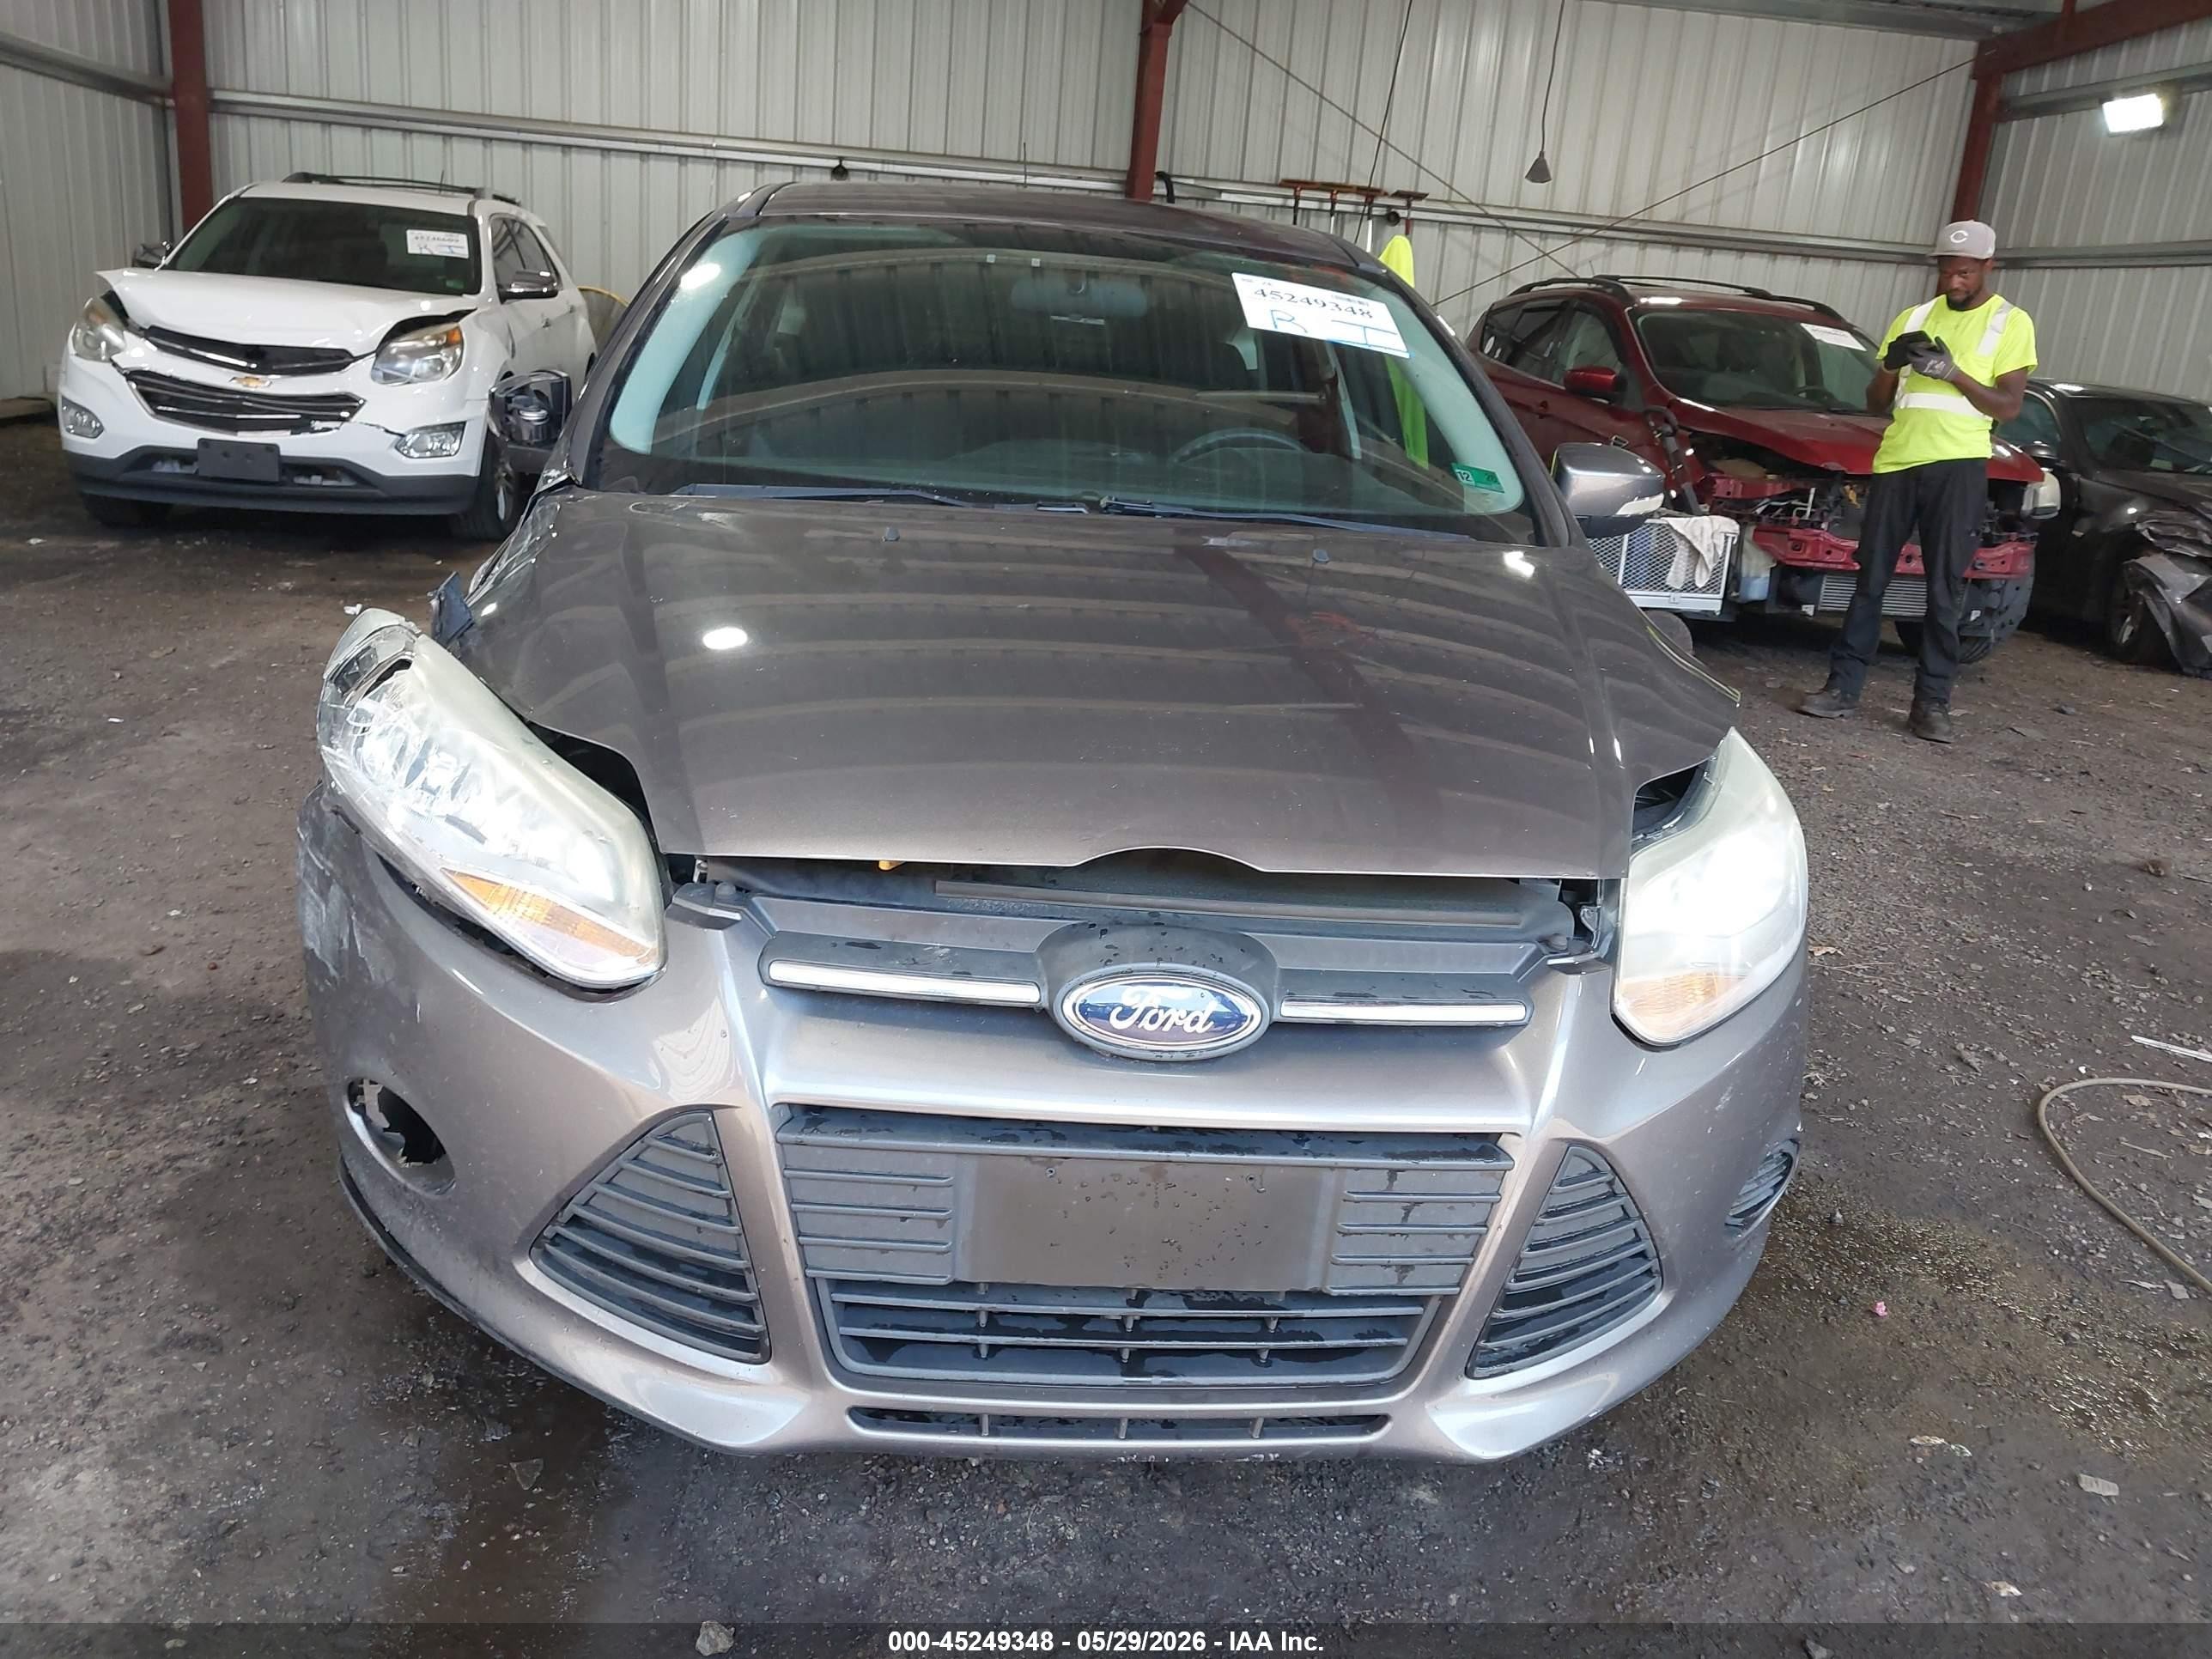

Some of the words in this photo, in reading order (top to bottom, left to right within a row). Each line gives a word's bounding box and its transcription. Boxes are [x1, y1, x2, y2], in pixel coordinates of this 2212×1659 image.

[1950, 230, 1969, 243] C
[1254, 289, 1374, 319] 45249348
[1270, 309, 1309, 334] R
[1456, 471, 1474, 482] 12
[1109, 986, 1216, 1034] Ford
